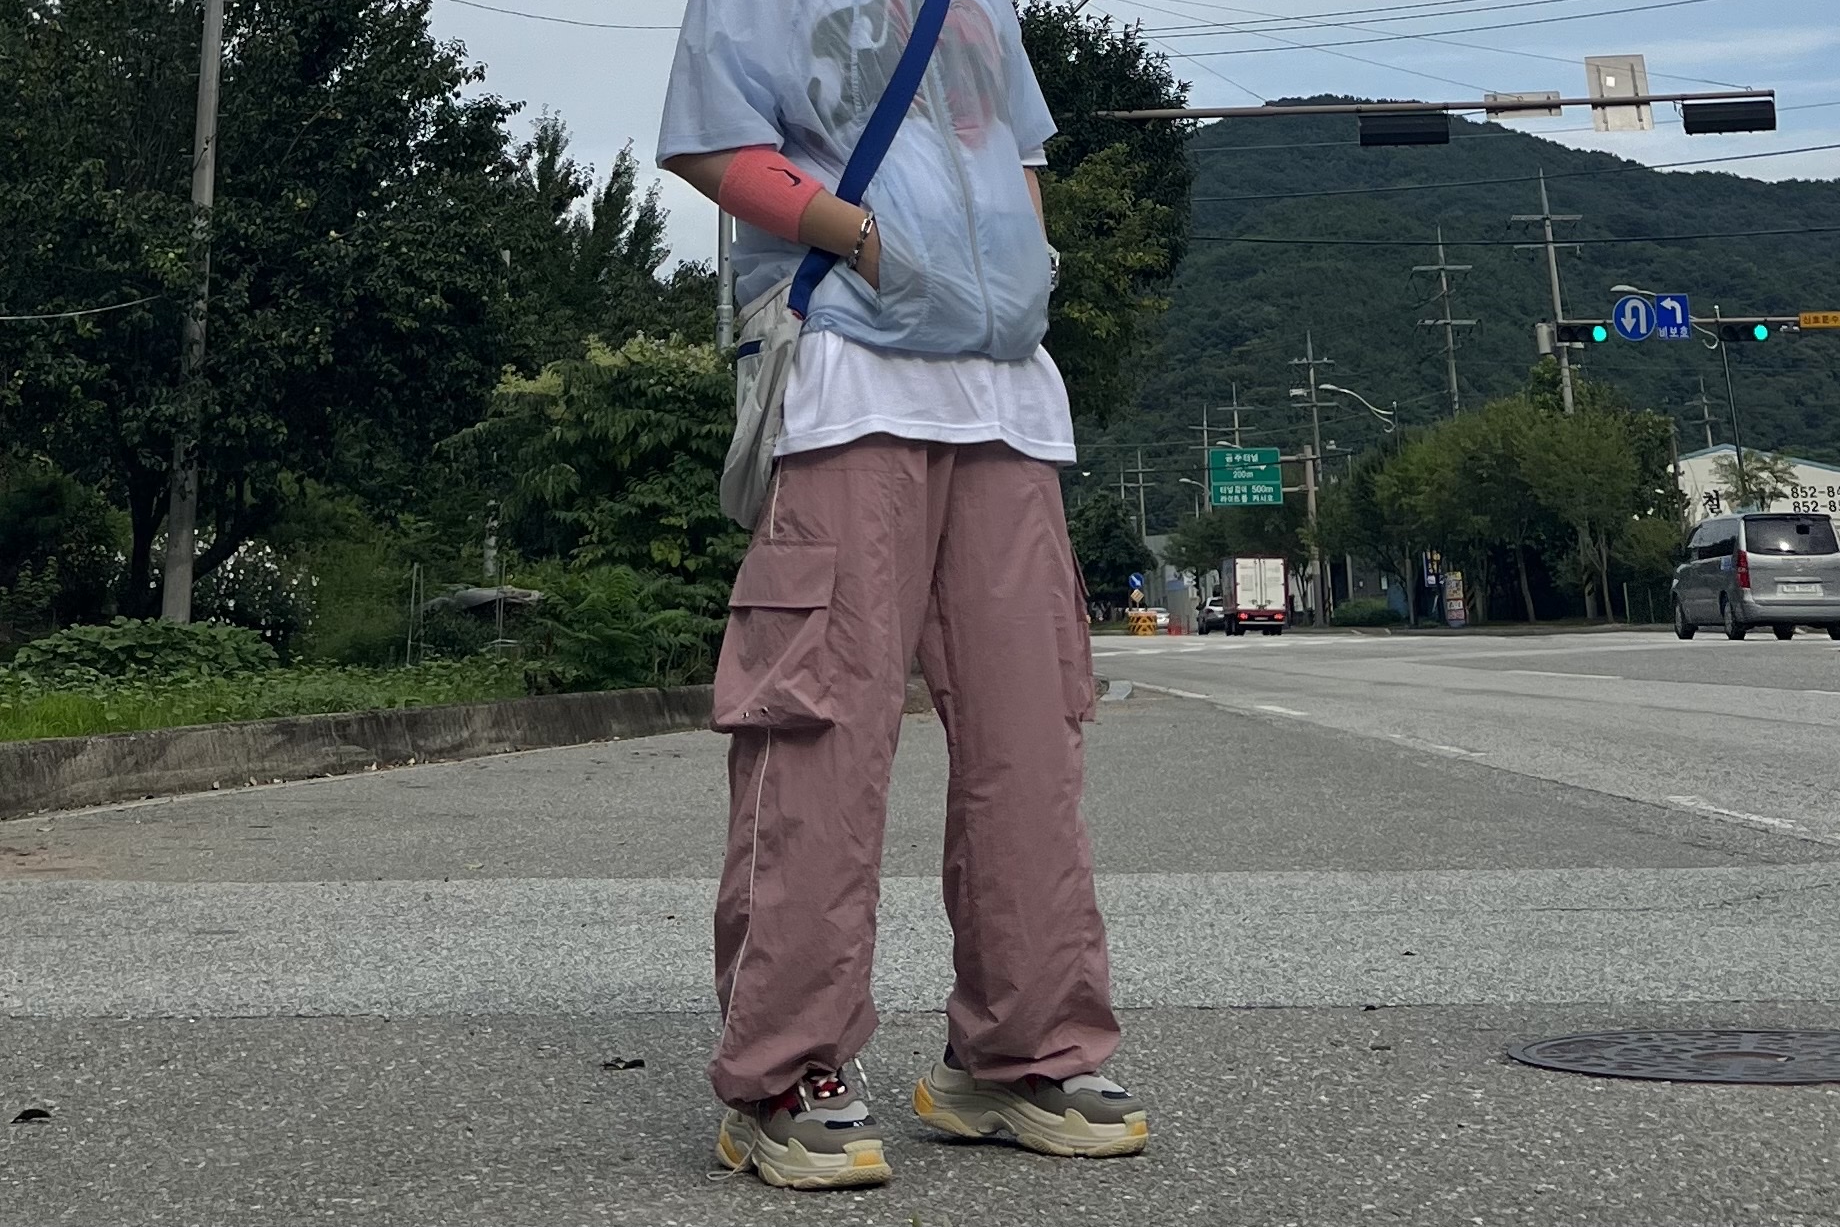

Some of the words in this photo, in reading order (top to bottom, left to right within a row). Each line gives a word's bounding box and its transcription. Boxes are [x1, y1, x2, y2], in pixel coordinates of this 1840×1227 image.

[1659, 326, 1689, 339] 비보호
[1233, 470, 1253, 478] 200m
[1252, 485, 1273, 493] 500m
[1793, 500, 1840, 513] 852-8
